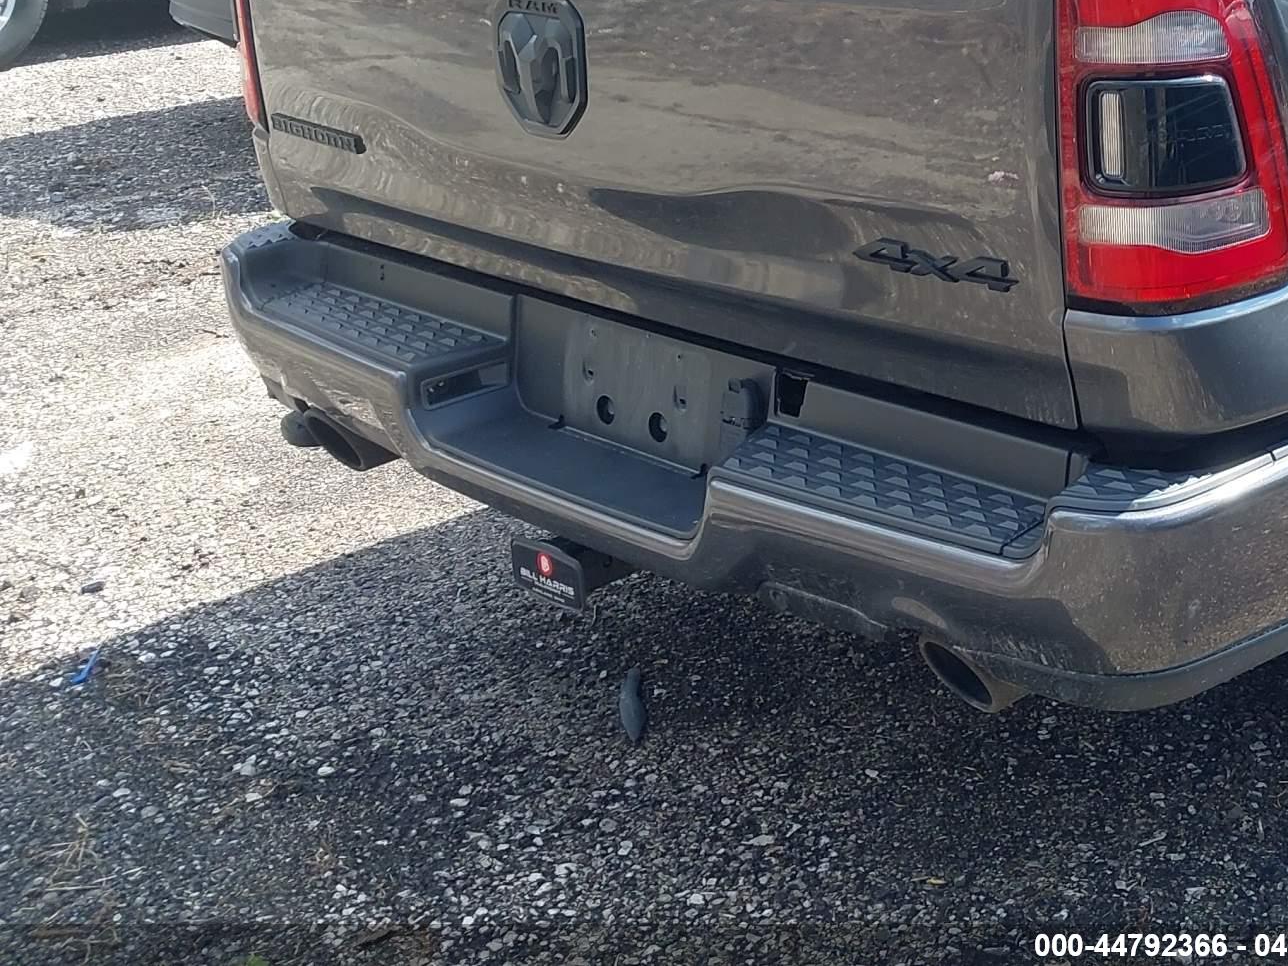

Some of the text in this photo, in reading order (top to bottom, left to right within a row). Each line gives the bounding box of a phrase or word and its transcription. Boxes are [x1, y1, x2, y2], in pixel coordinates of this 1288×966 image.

[271, 114, 359, 155] BIGHORN
[520, 566, 539, 581] BILL
[539, 575, 575, 596] HARRIS
